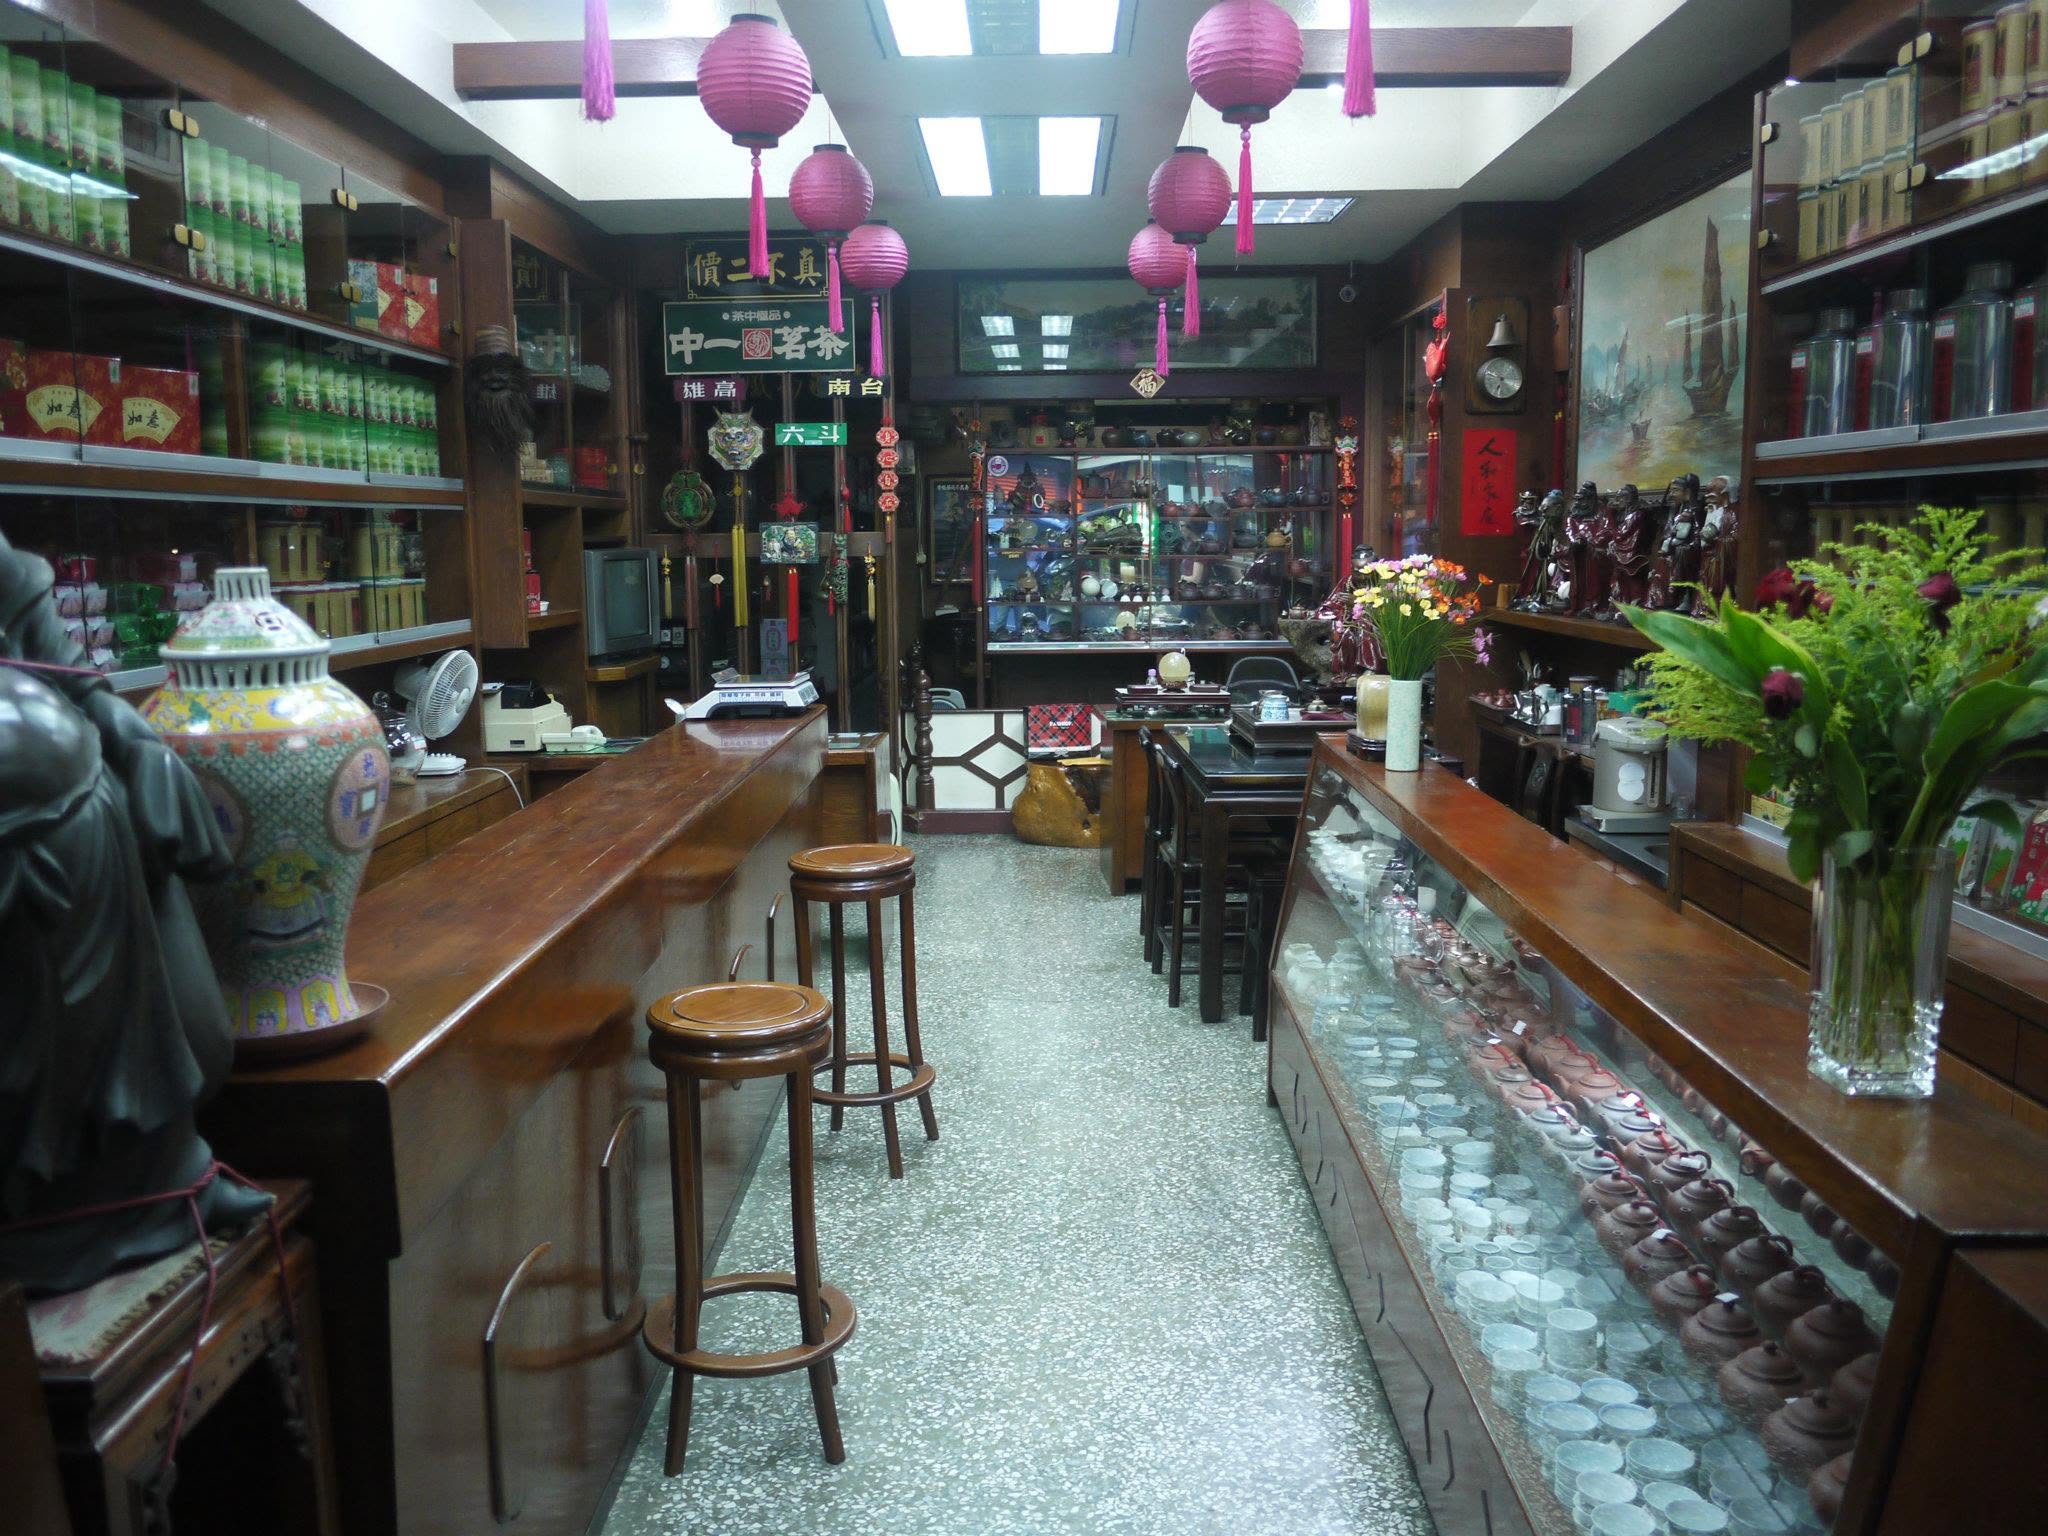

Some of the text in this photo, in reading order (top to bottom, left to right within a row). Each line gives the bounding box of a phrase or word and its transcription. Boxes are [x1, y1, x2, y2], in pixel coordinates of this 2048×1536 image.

[731, 310, 782, 322] 茶中極品
[669, 325, 849, 365] 中一 茗茶
[683, 380, 737, 399] 高雄
[828, 378, 883, 396] 台南
[127, 409, 160, 429] 如意
[782, 424, 840, 444] 斗六
